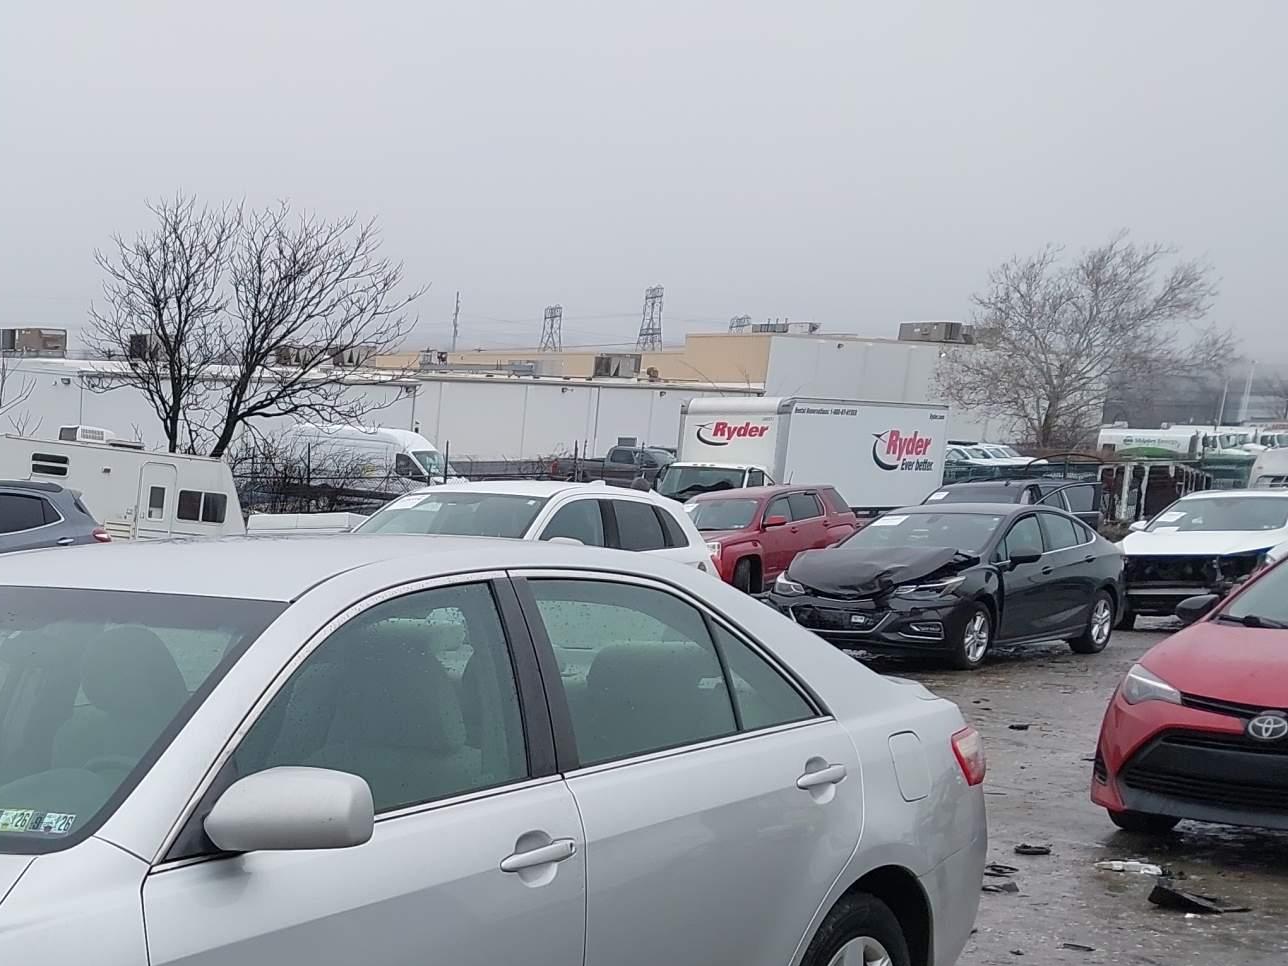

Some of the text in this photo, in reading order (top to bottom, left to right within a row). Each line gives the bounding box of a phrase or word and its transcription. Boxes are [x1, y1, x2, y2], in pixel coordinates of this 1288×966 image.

[712, 421, 769, 440] Ryder
[886, 430, 932, 461] Ryder
[901, 458, 915, 471] Ever
